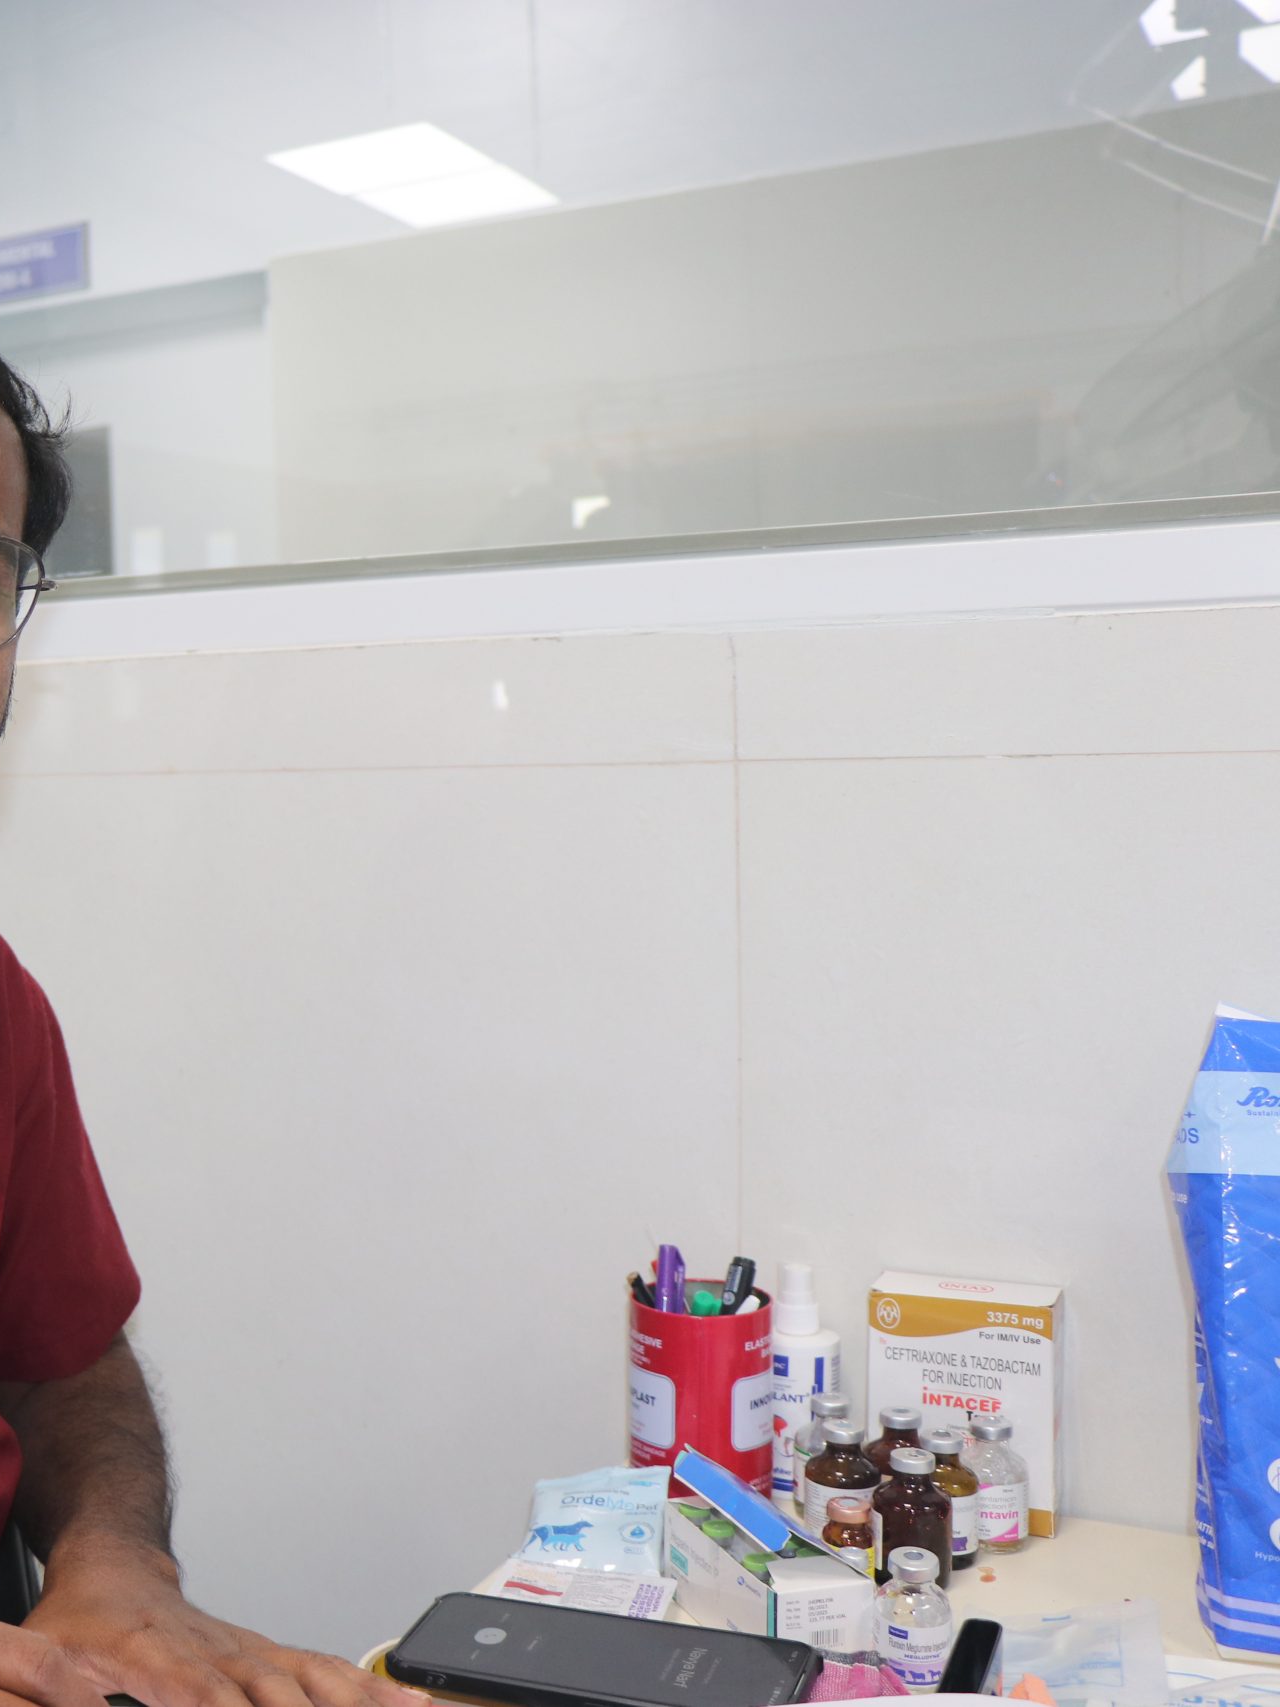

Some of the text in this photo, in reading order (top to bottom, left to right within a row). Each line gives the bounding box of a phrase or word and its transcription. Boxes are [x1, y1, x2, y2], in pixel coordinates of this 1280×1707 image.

[987, 1311, 1044, 1329] 3375 mg
[979, 1331, 1041, 1345] For IM/IV Use
[885, 1346, 1042, 1377] CEFTRIAXONE & TAZOBACTAM
[922, 1368, 1002, 1391] FOR INJECTION
[980, 1510, 1019, 1520] ntavin
